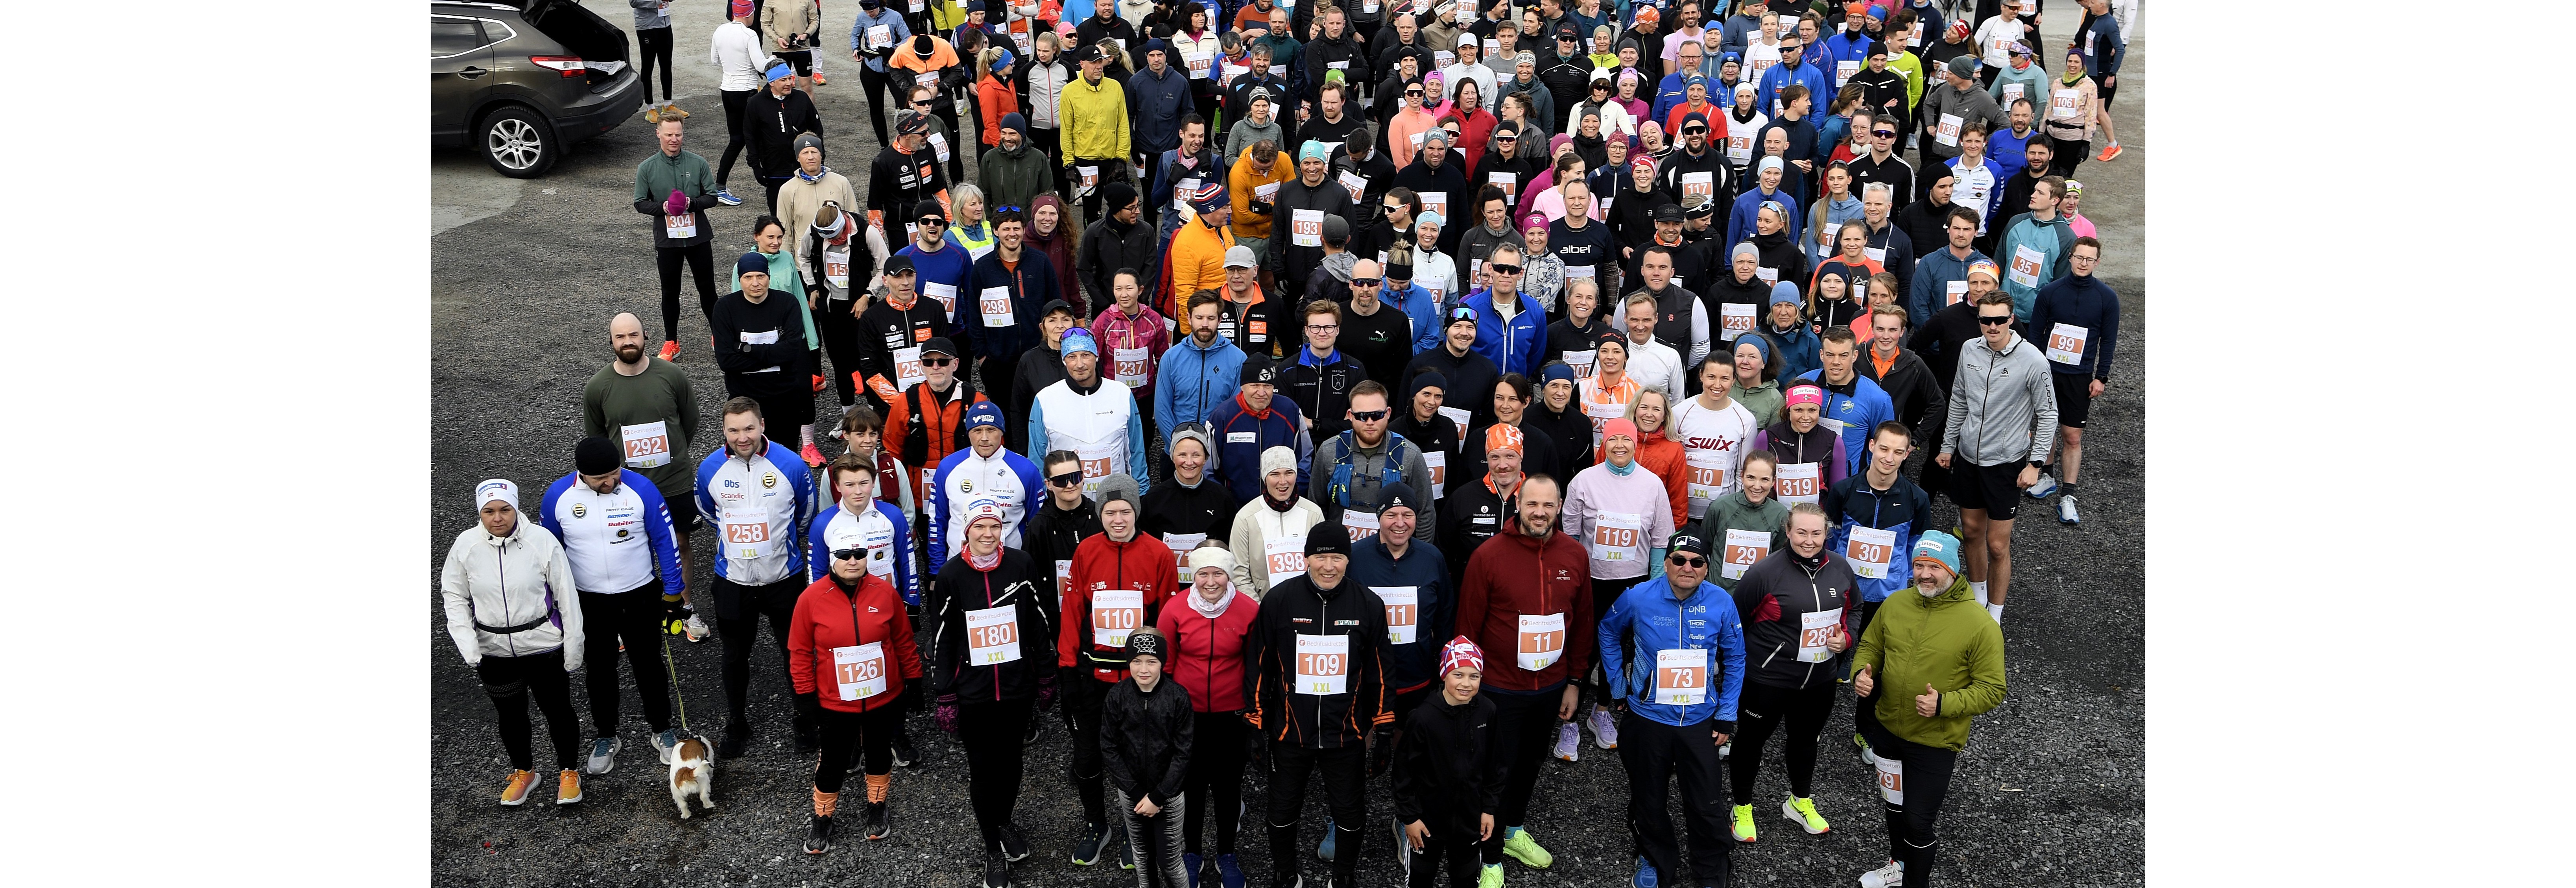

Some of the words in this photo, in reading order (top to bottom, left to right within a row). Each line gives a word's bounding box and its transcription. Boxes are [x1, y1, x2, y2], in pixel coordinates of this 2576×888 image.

[872, 34, 888, 44] 306
[1015, 39, 1027, 48] 212
[1192, 60, 1208, 69] 174
[1439, 58, 1452, 67] 236
[1757, 61, 1771, 69] 151
[2006, 93, 2020, 102] 205
[2057, 98, 2072, 107] 106
[1942, 125, 1956, 135] 138
[934, 142, 946, 153] 203
[1732, 138, 1743, 148] 25
[1688, 183, 1707, 195] 117
[671, 216, 691, 227] 304
[1298, 222, 1318, 235] 193
[1561, 245, 1590, 253] aibel
[832, 264, 847, 275] 15
[2019, 259, 2032, 273] 35
[2016, 275, 2027, 284] XXL
[984, 300, 1006, 314] 298
[1727, 316, 1751, 330] 233
[2058, 337, 2075, 352] 99
[2057, 354, 2069, 363] XXL
[1120, 361, 1143, 375] 237
[632, 438, 661, 457] 292
[1084, 461, 1102, 476] 54
[1695, 469, 1712, 485] 10
[1783, 479, 1812, 496] 319
[1694, 489, 1708, 498] XXL
[969, 500, 994, 511] SpareBank
[732, 525, 762, 542] 258
[1604, 528, 1631, 546] 119
[1859, 531, 1893, 540] Bedriftsidretten
[1736, 547, 1757, 564] 29
[1859, 544, 1880, 562] 30
[1275, 553, 1305, 572] 398
[1858, 567, 1873, 576] XXL
[1689, 603, 1706, 615] DNB
[977, 610, 1014, 620] Bedriftsidretten
[1102, 610, 1133, 628] 110
[977, 624, 1011, 646] 180
[1391, 633, 1401, 642] XL
[1534, 633, 1550, 652] 11
[845, 647, 880, 657] Bedriftsidretten
[987, 651, 1004, 662] XXL
[1306, 655, 1339, 675] 109
[1534, 659, 1548, 668] XXL
[845, 660, 878, 683] 126
[1671, 669, 1692, 688] 73
[856, 686, 873, 697] XXL
[1313, 683, 1330, 692] XXL
[1673, 695, 1690, 703] XXL
